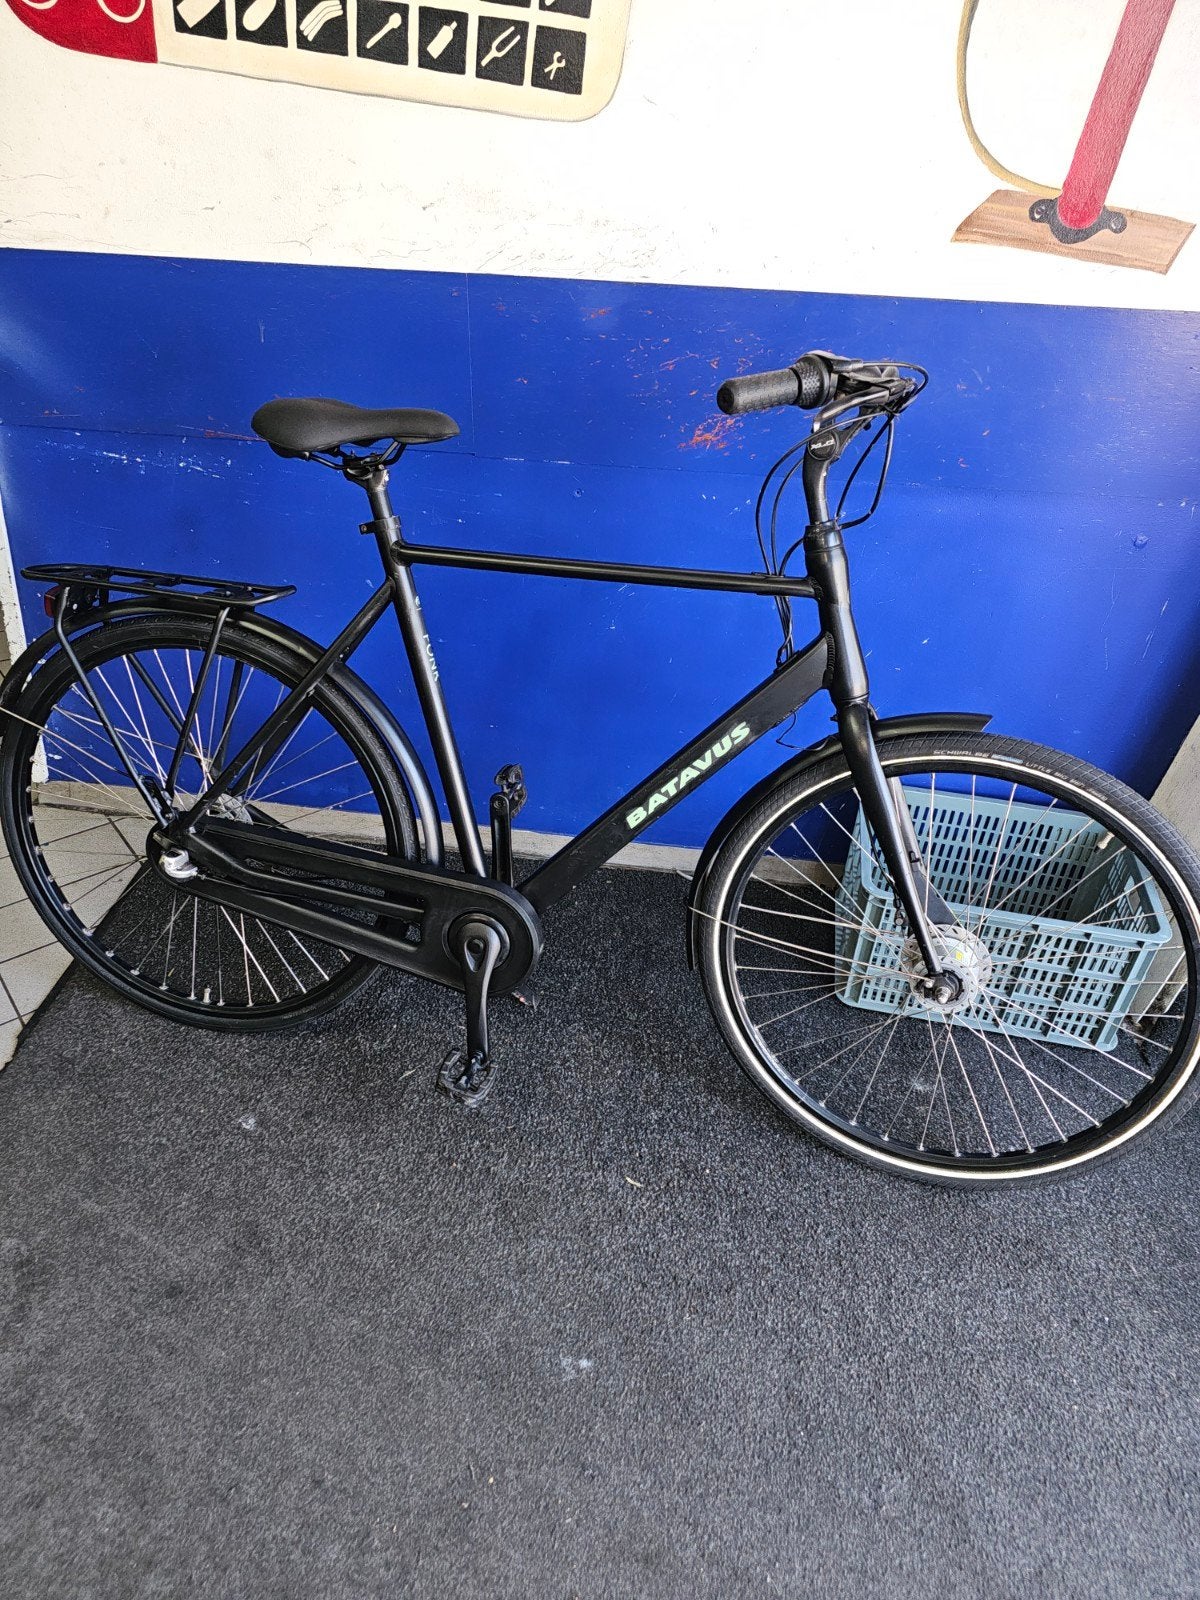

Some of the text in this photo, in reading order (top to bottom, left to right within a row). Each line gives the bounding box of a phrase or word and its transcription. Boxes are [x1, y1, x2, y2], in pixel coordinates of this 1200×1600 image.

[625, 721, 751, 829] BATAVUS
[933, 749, 991, 758] SCHWALBE
[1025, 761, 1053, 774] LITTLE
